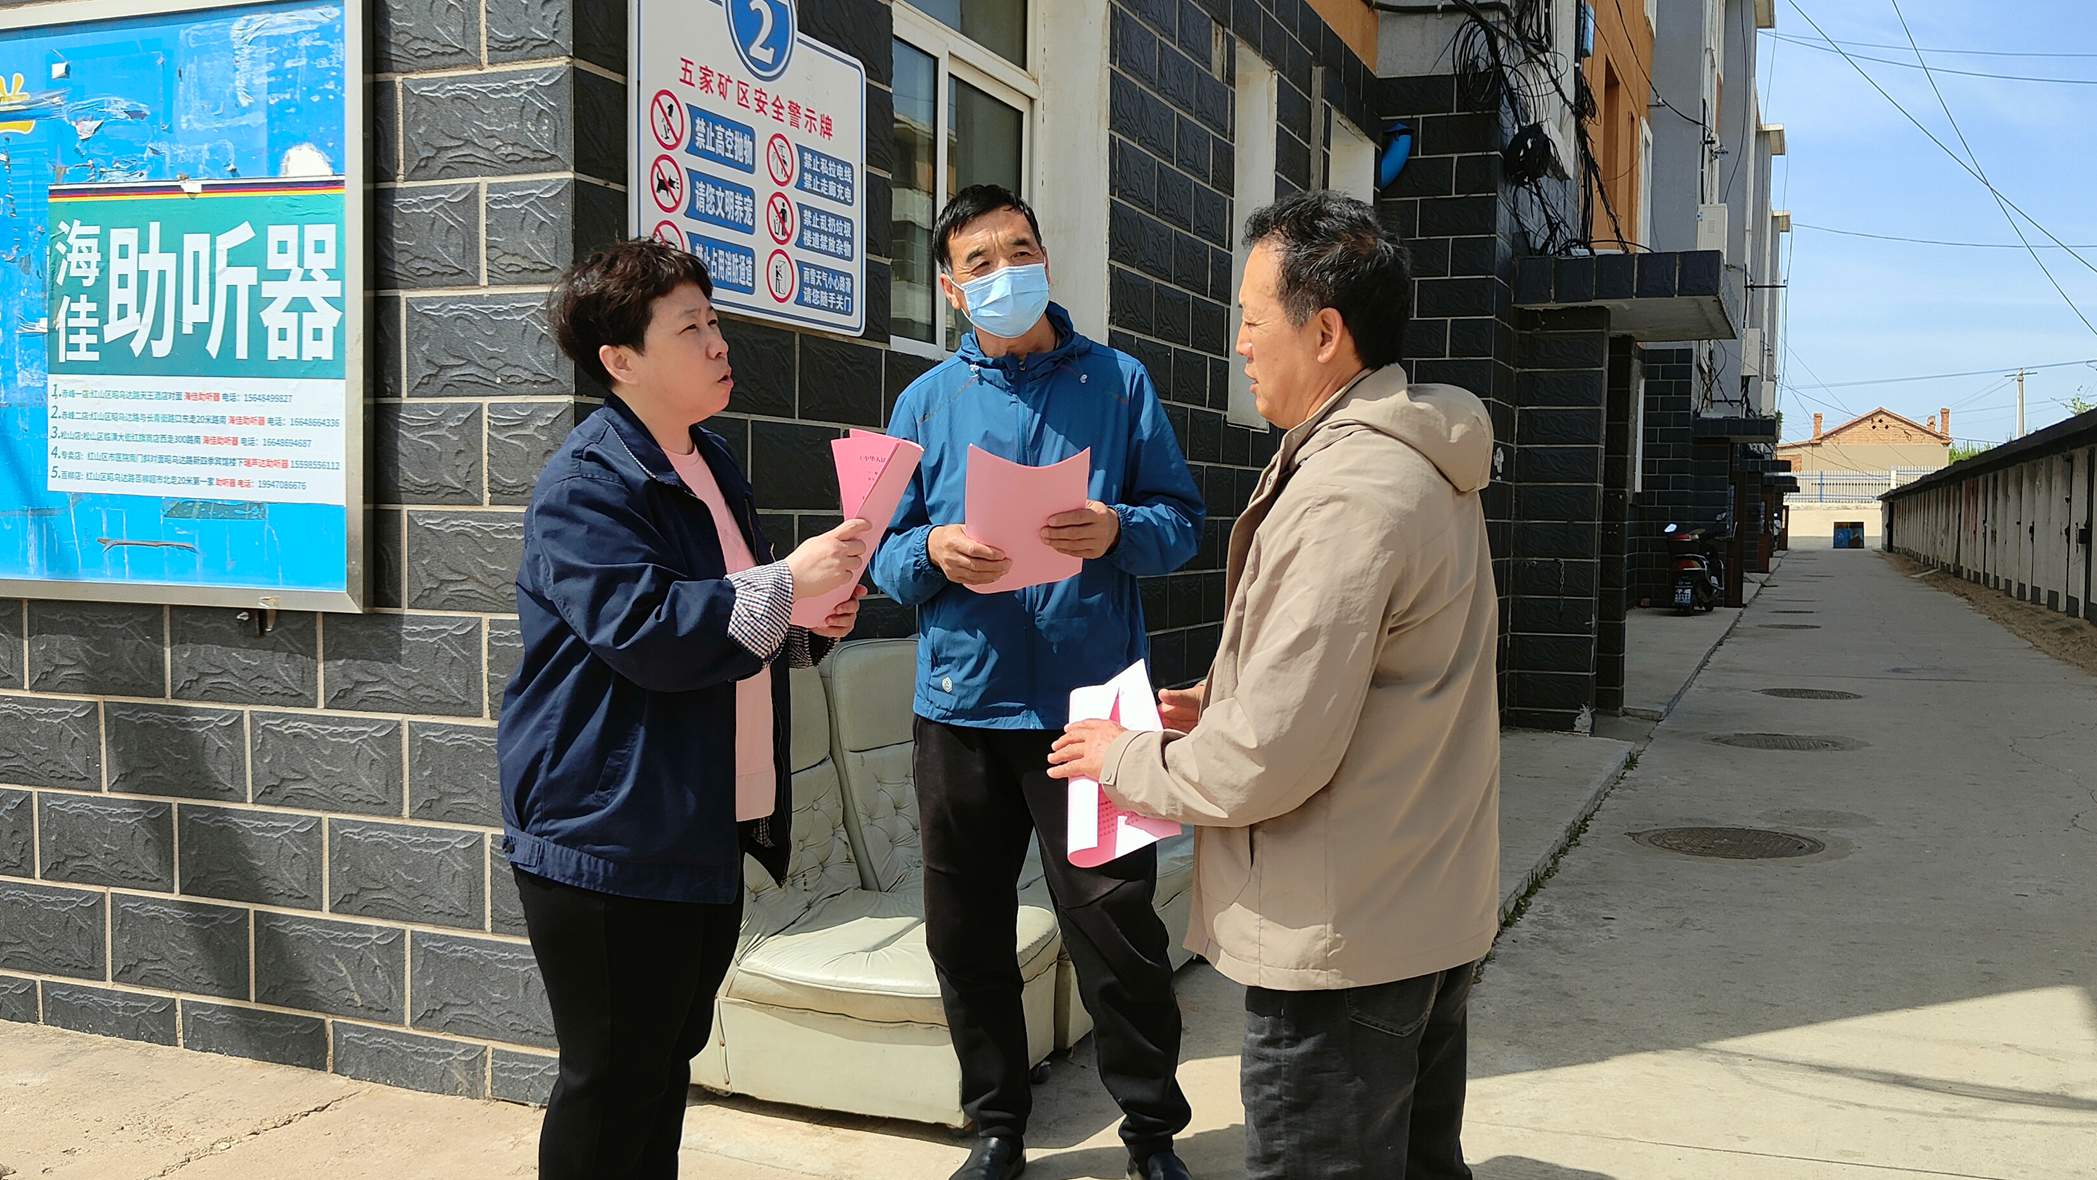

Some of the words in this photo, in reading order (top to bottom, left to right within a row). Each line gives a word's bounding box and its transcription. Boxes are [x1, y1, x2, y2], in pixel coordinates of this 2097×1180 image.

[749, 0, 774, 64] 2
[679, 57, 833, 141] 五家矿区安全警示牌
[694, 116, 753, 167] 禁止高空抛物
[803, 151, 853, 184] 禁止私拉电线
[803, 172, 853, 202] 禁止走廊充电
[694, 180, 753, 226] 请您文明养宠
[803, 208, 853, 238] 禁止乱扔垃圾
[803, 230, 853, 259] 楼道禁放杂物
[54, 218, 102, 364] 海佳
[103, 220, 342, 361] 助听器
[803, 286, 852, 313] 请您随手关门
